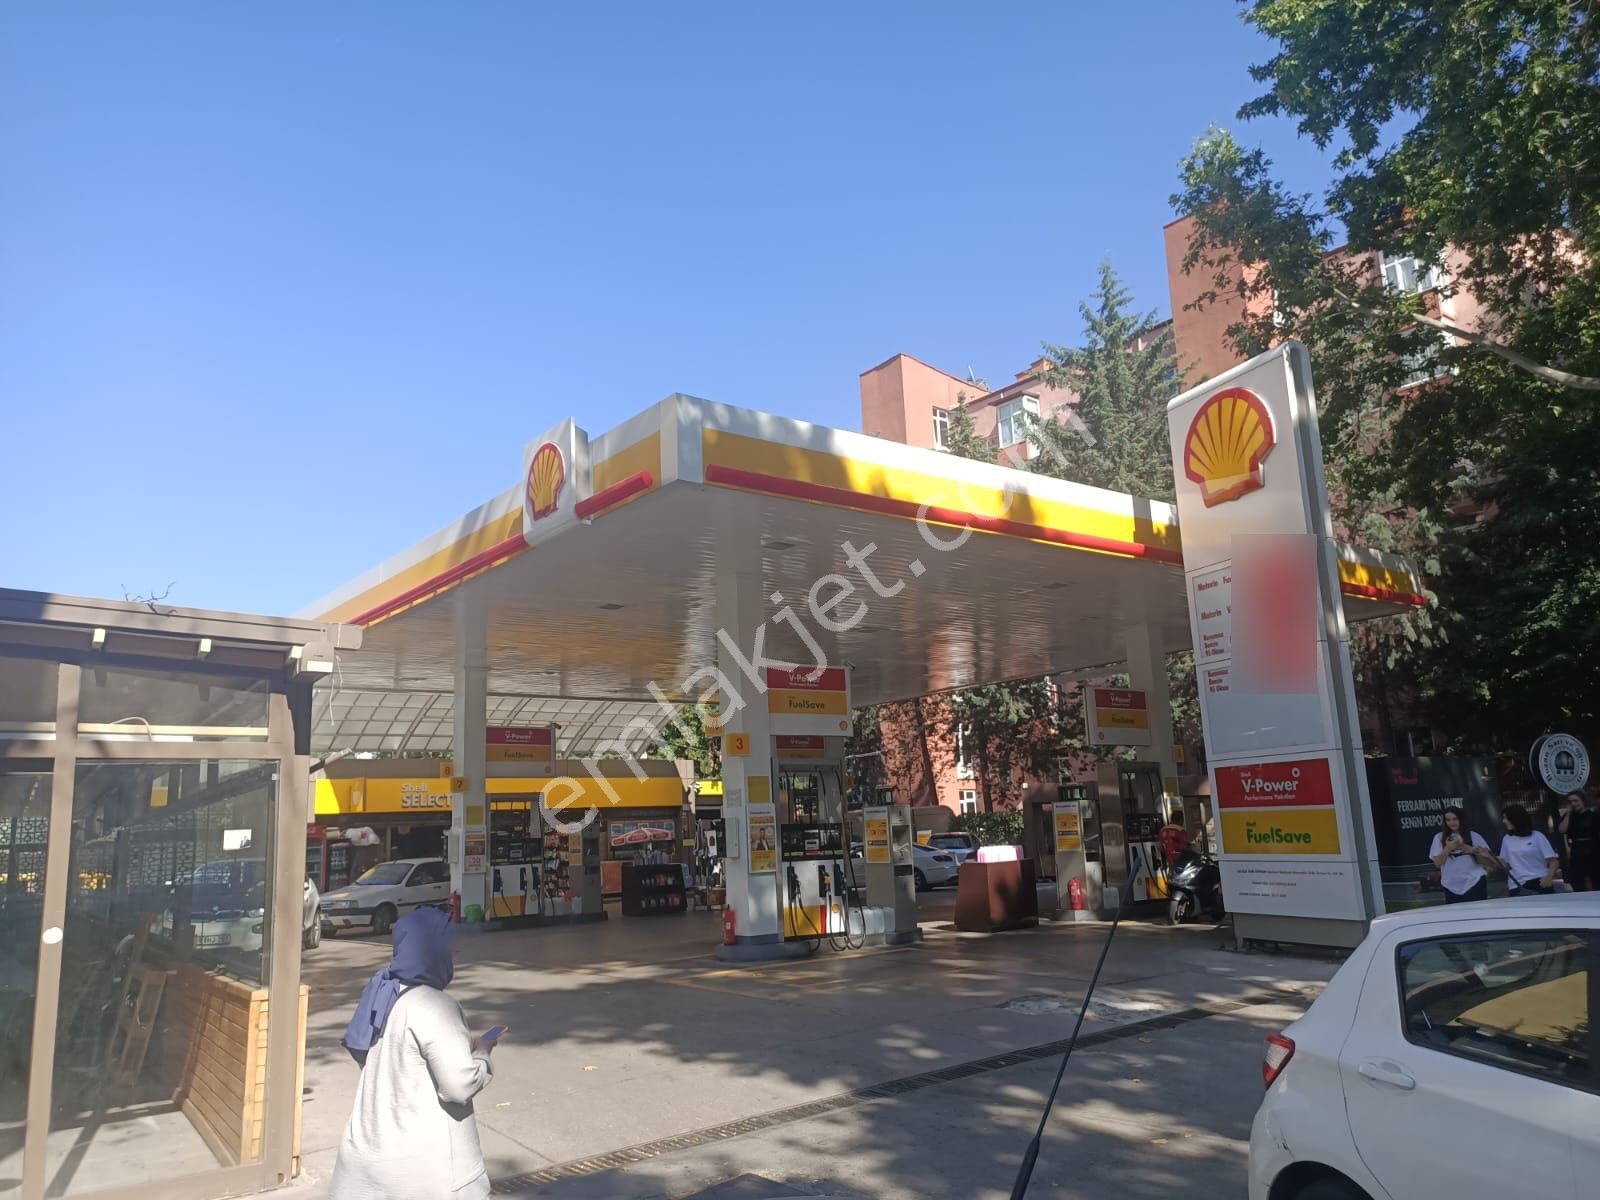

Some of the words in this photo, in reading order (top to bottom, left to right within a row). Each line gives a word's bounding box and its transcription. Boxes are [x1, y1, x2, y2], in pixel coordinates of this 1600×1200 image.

[788, 699, 825, 709] FuelSave
[736, 738, 743, 750] 3
[401, 783, 428, 793] Shell
[1241, 778, 1299, 793] V-Power
[402, 793, 453, 808] SELECT
[1424, 814, 1443, 827] DEPO
[1247, 827, 1312, 843] FuelSave
